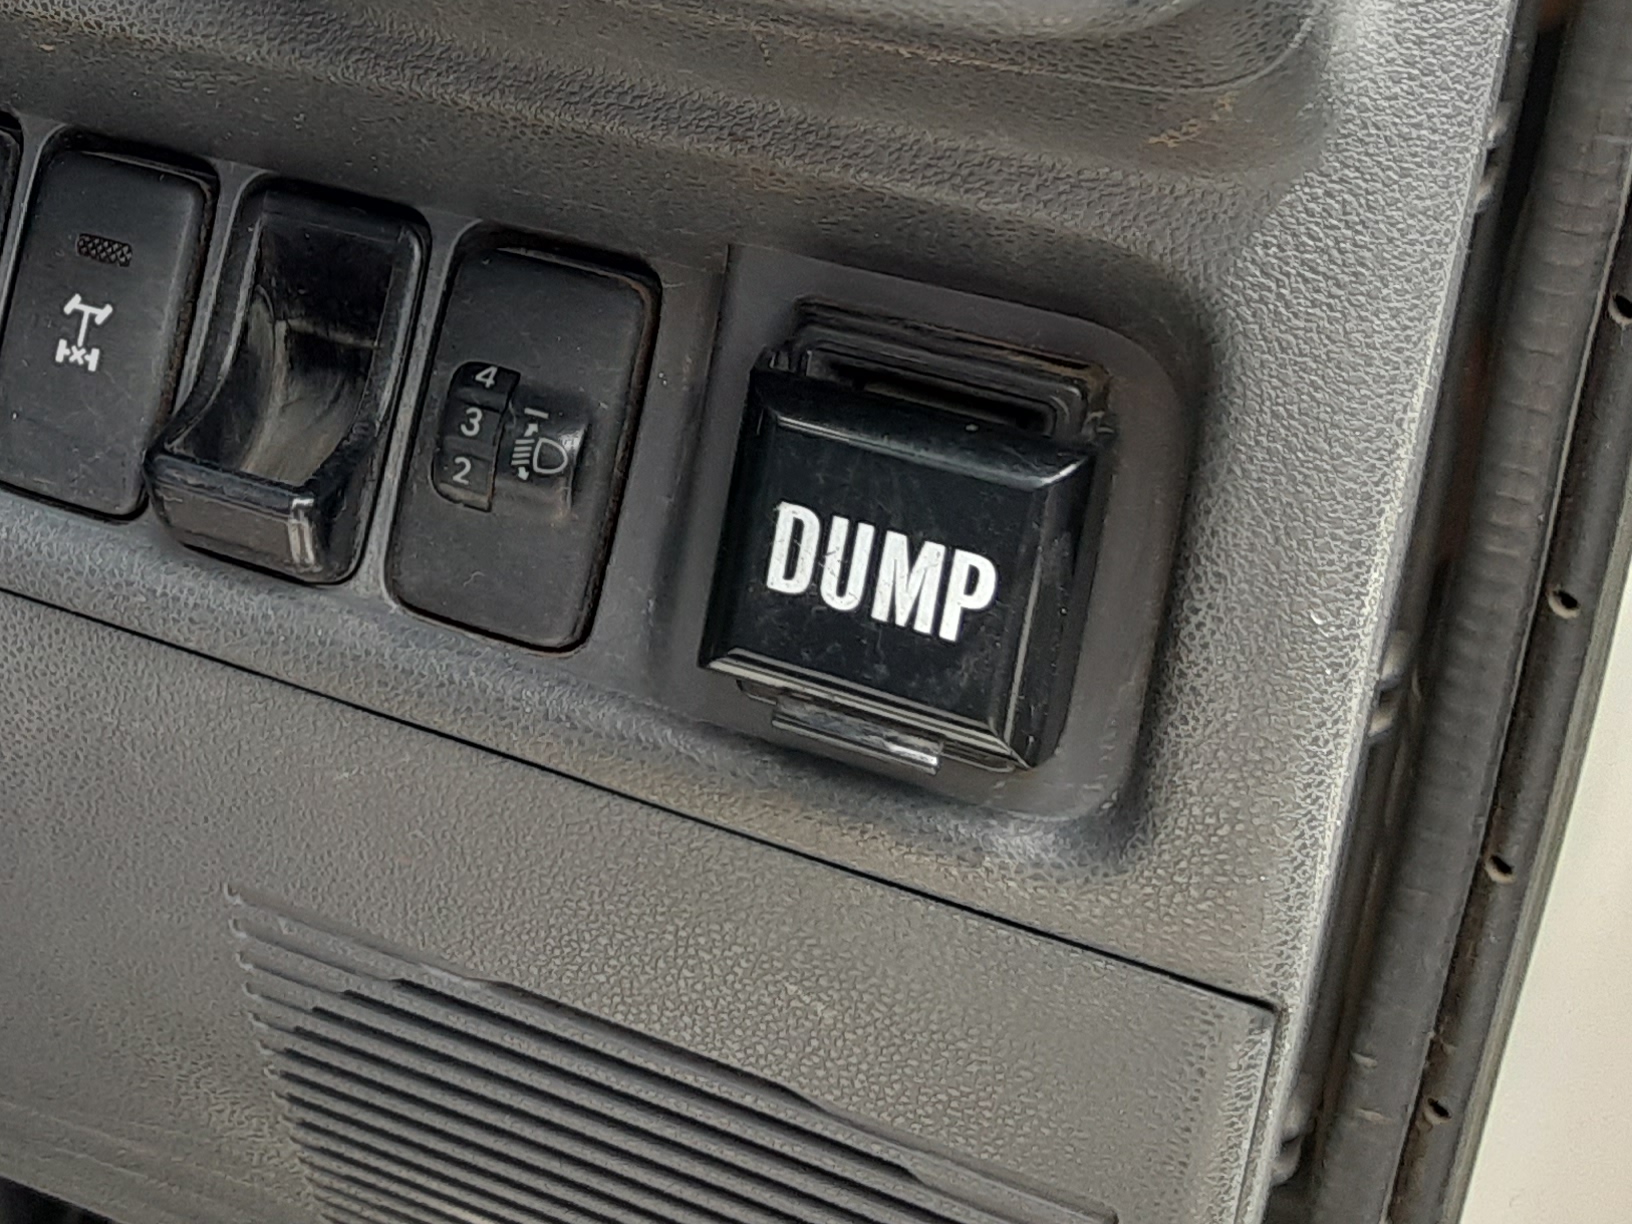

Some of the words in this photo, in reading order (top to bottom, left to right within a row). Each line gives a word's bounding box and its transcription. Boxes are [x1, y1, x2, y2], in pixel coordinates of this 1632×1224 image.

[475, 366, 498, 388] 4
[460, 407, 483, 437] 3
[452, 456, 472, 485] 2
[766, 500, 998, 643] DUMP
